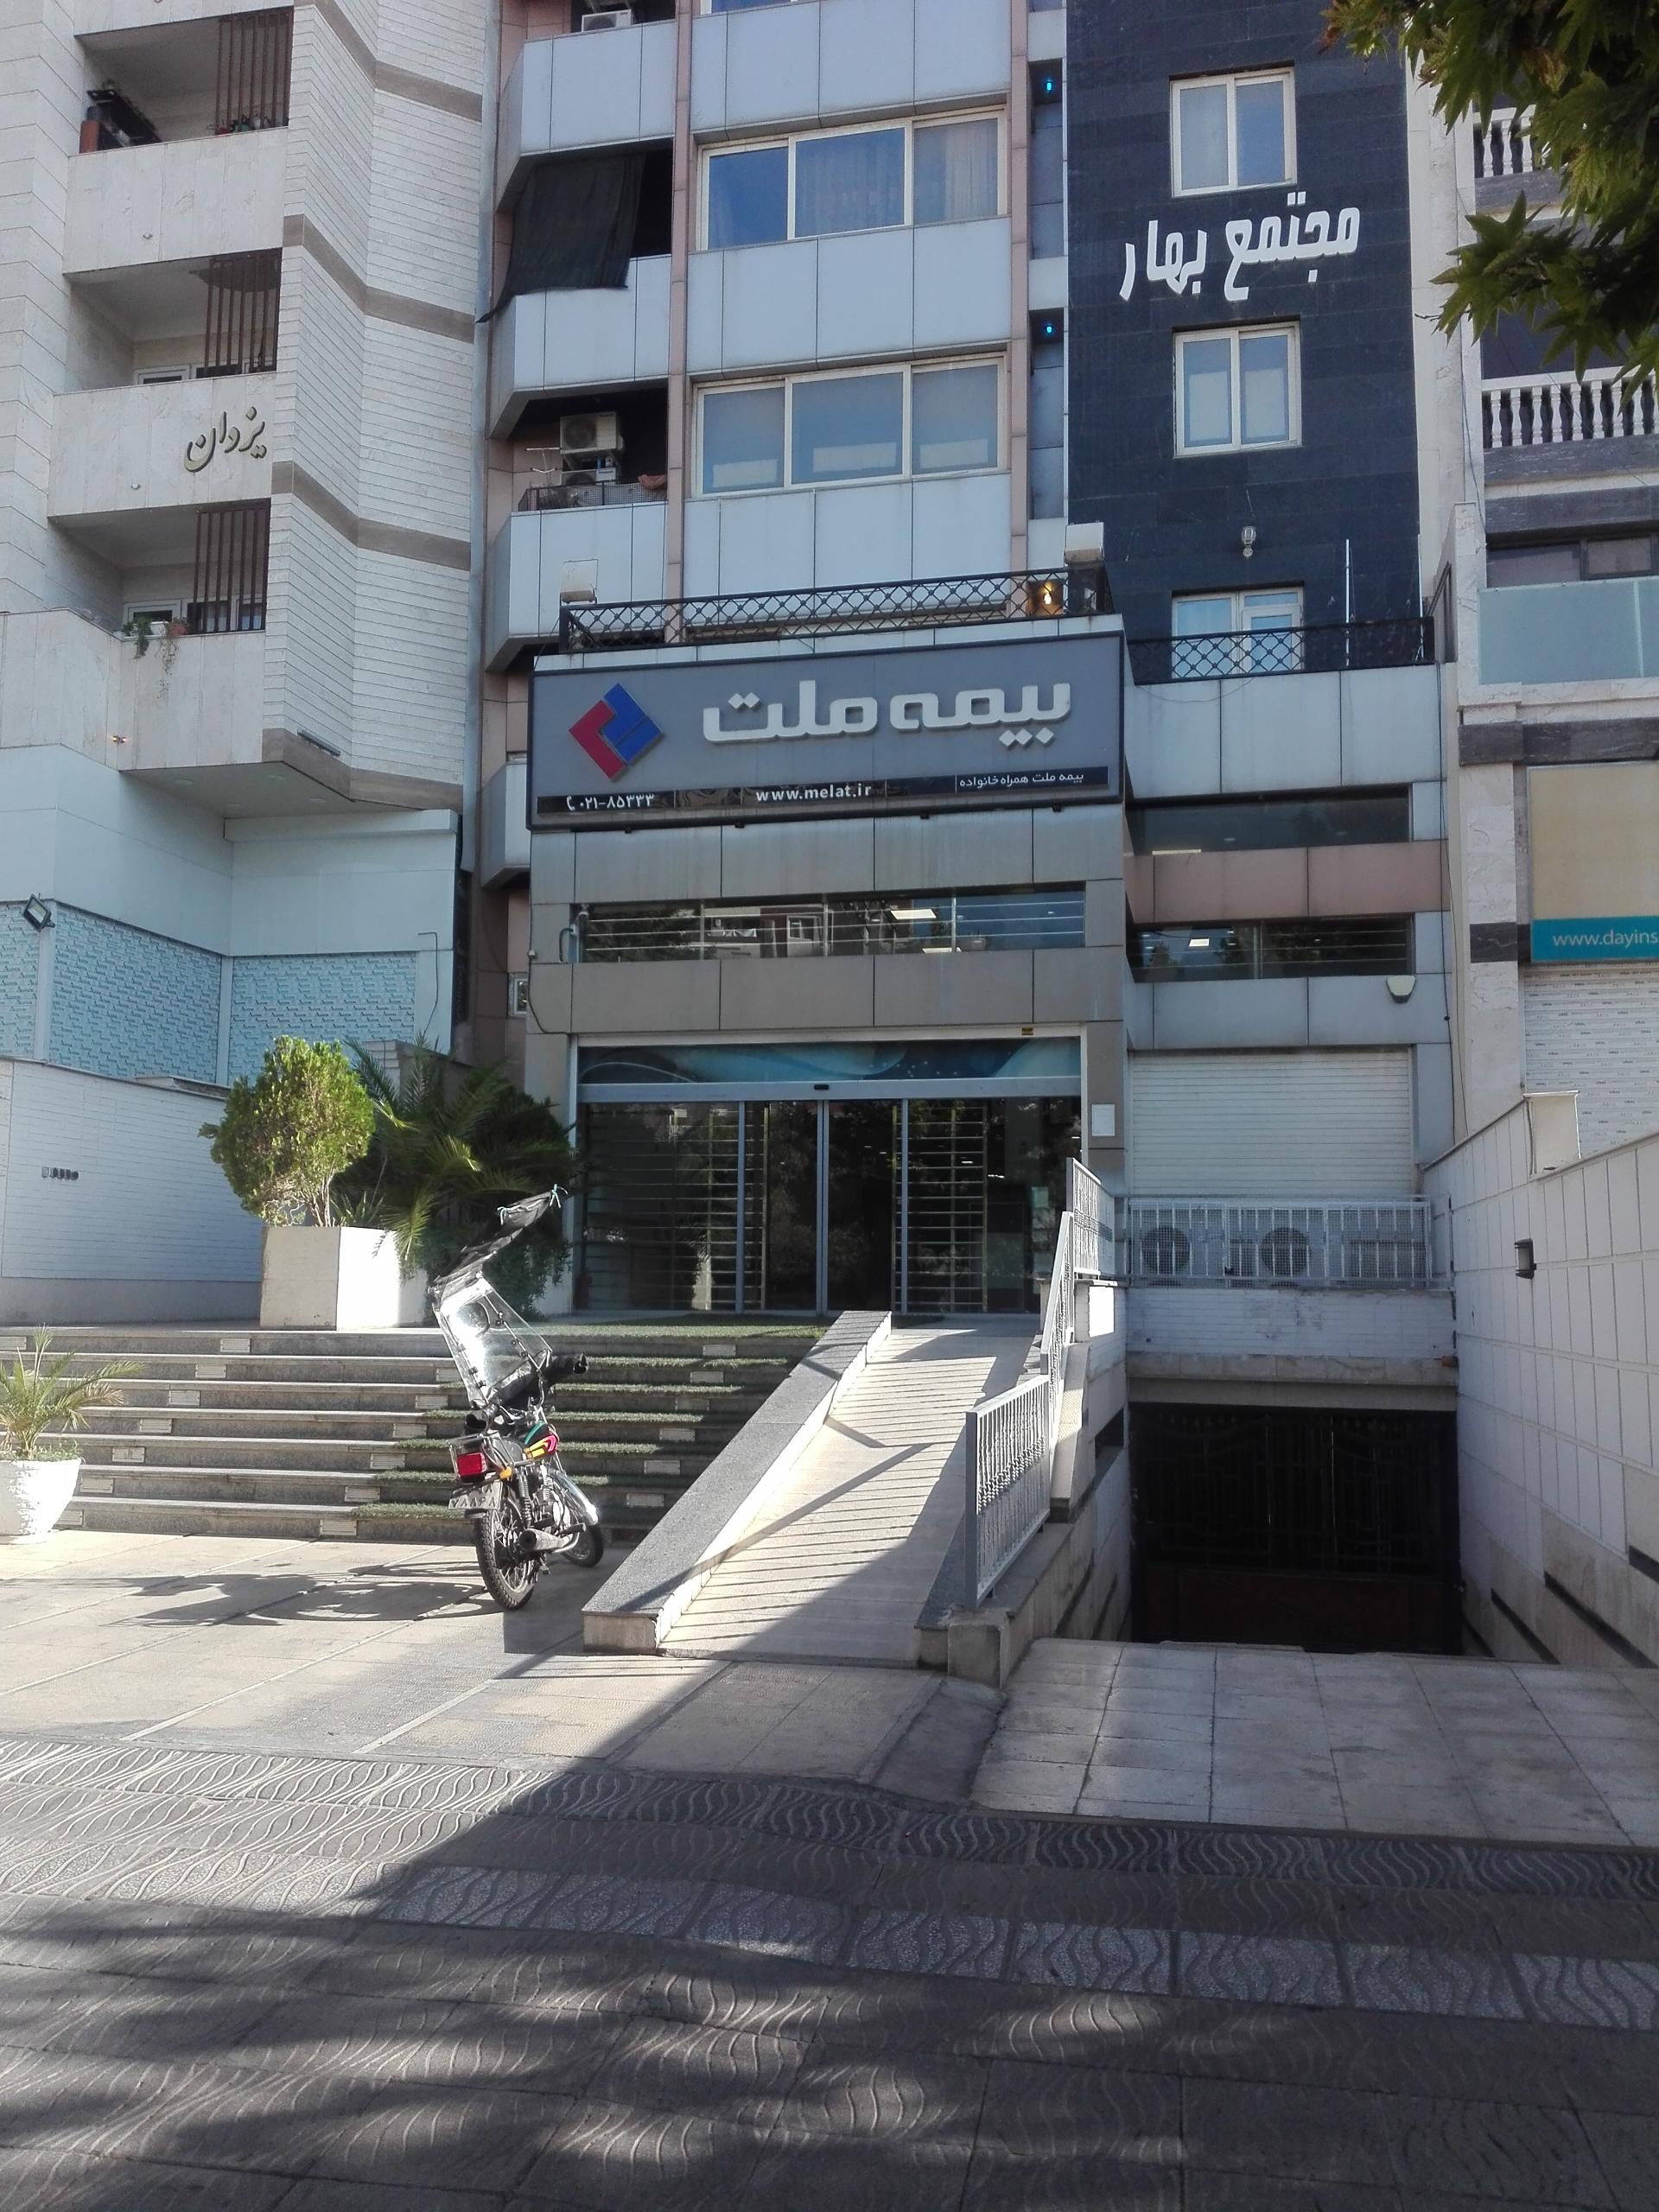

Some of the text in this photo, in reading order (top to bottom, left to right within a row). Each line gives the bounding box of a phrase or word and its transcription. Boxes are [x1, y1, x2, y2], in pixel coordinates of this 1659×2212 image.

[1119, 191, 1360, 302] مجتمع بهار
[184, 406, 268, 473] یزدان
[702, 679, 1071, 748] بیمه ملت
[755, 782, 872, 802] www.melat.ir
[959, 772, 1084, 789] بیمه ملت همراه خانواده
